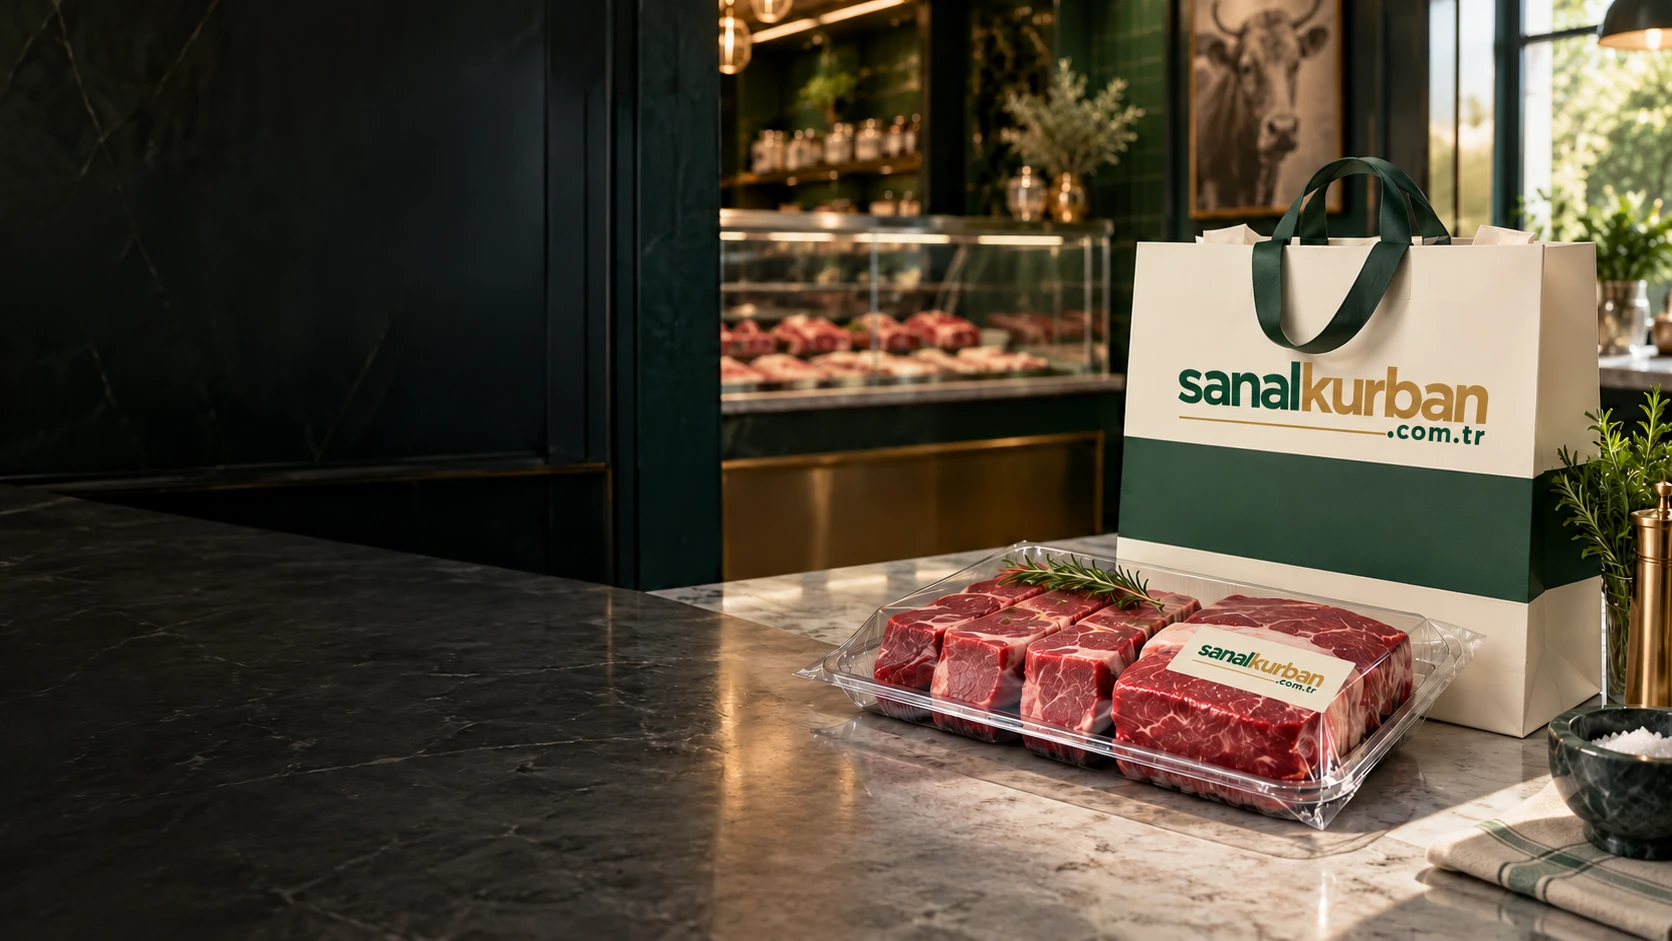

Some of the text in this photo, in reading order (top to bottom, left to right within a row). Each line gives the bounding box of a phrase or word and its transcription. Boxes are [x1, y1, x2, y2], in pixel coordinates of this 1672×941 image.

[1178, 361, 1489, 424] sanalkurban
[1387, 424, 1485, 445] .com.tr
[1198, 644, 1325, 688] sanalkurban
[1275, 679, 1317, 694] .com.tr
